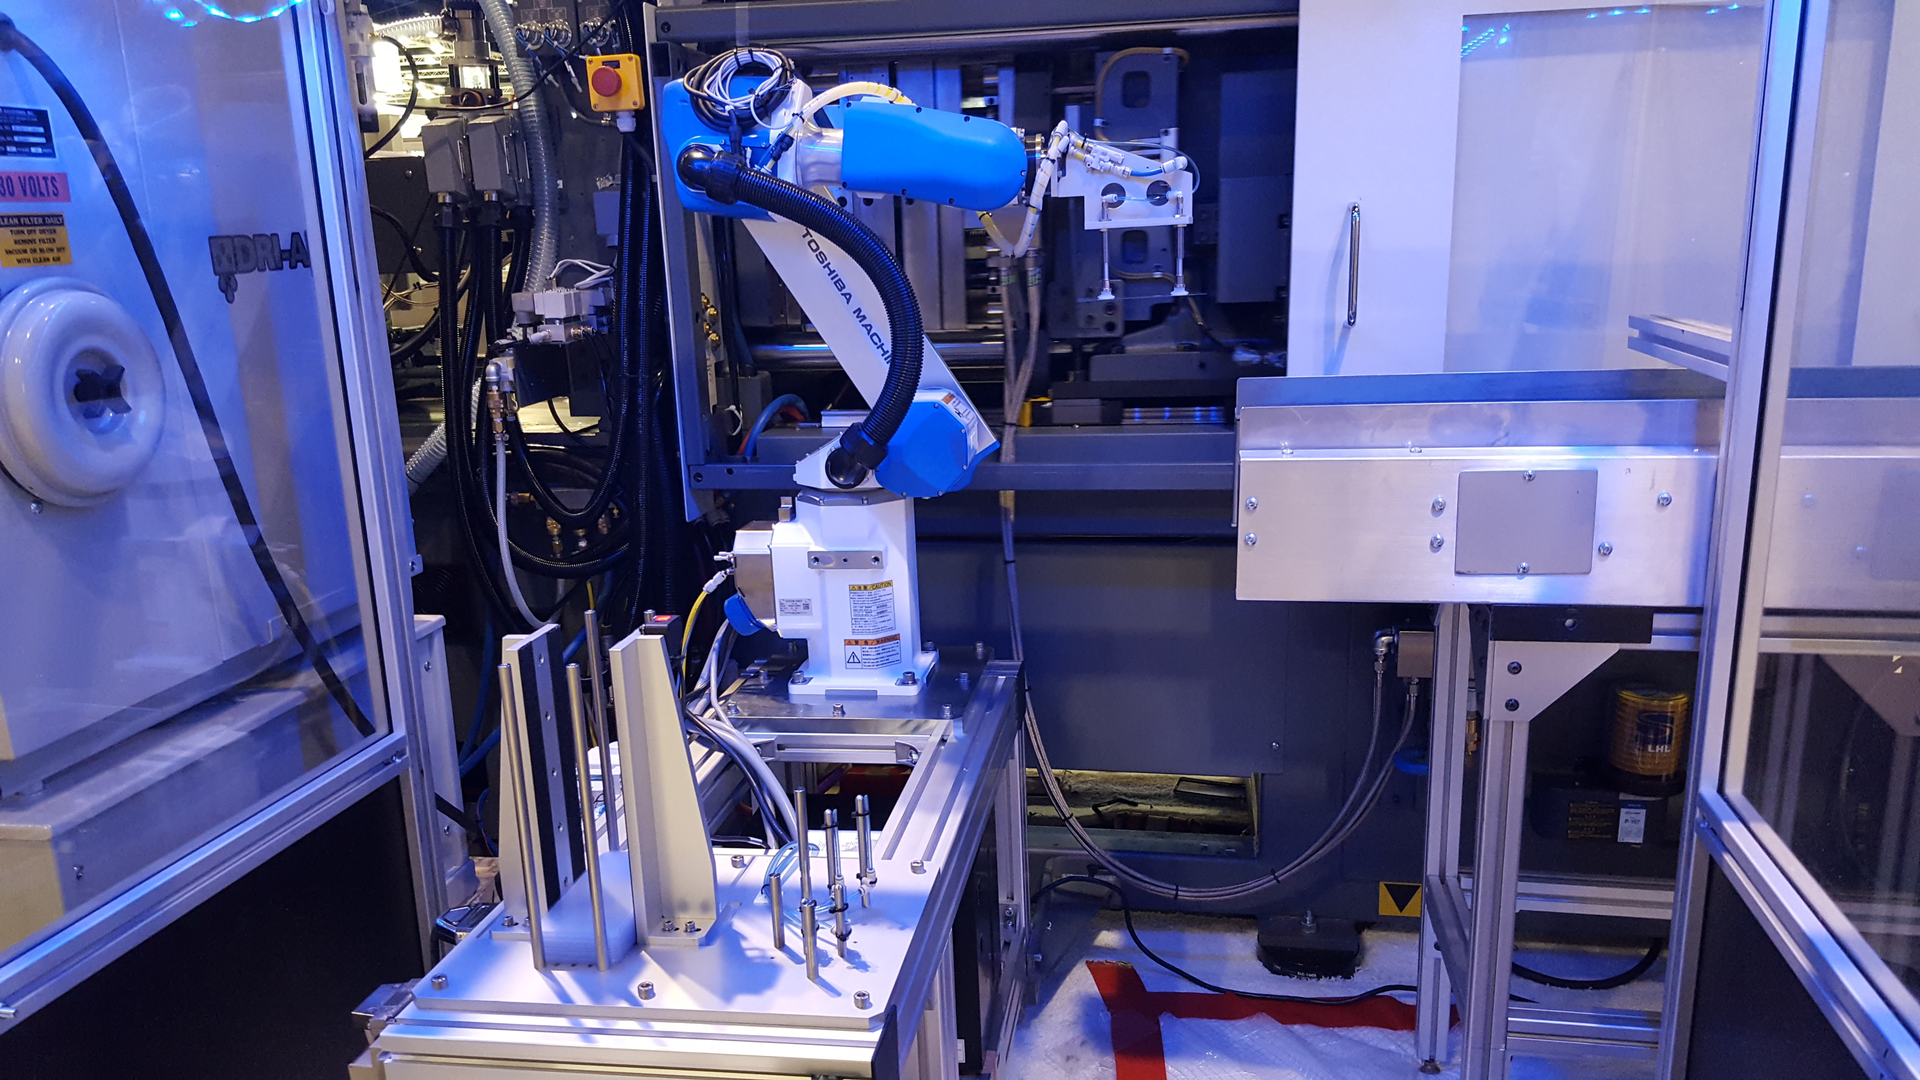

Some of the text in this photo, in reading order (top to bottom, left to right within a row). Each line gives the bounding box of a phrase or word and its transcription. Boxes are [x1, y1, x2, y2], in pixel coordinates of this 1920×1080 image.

[18, 175, 60, 197] VOLTS
[20, 216, 43, 225] FILTER
[45, 216, 63, 225] DAILY
[9, 228, 26, 236] TURN
[233, 231, 312, 274] DRI-A
[801, 227, 853, 305] TOSHIBA
[1648, 744, 1671, 753] LHL
